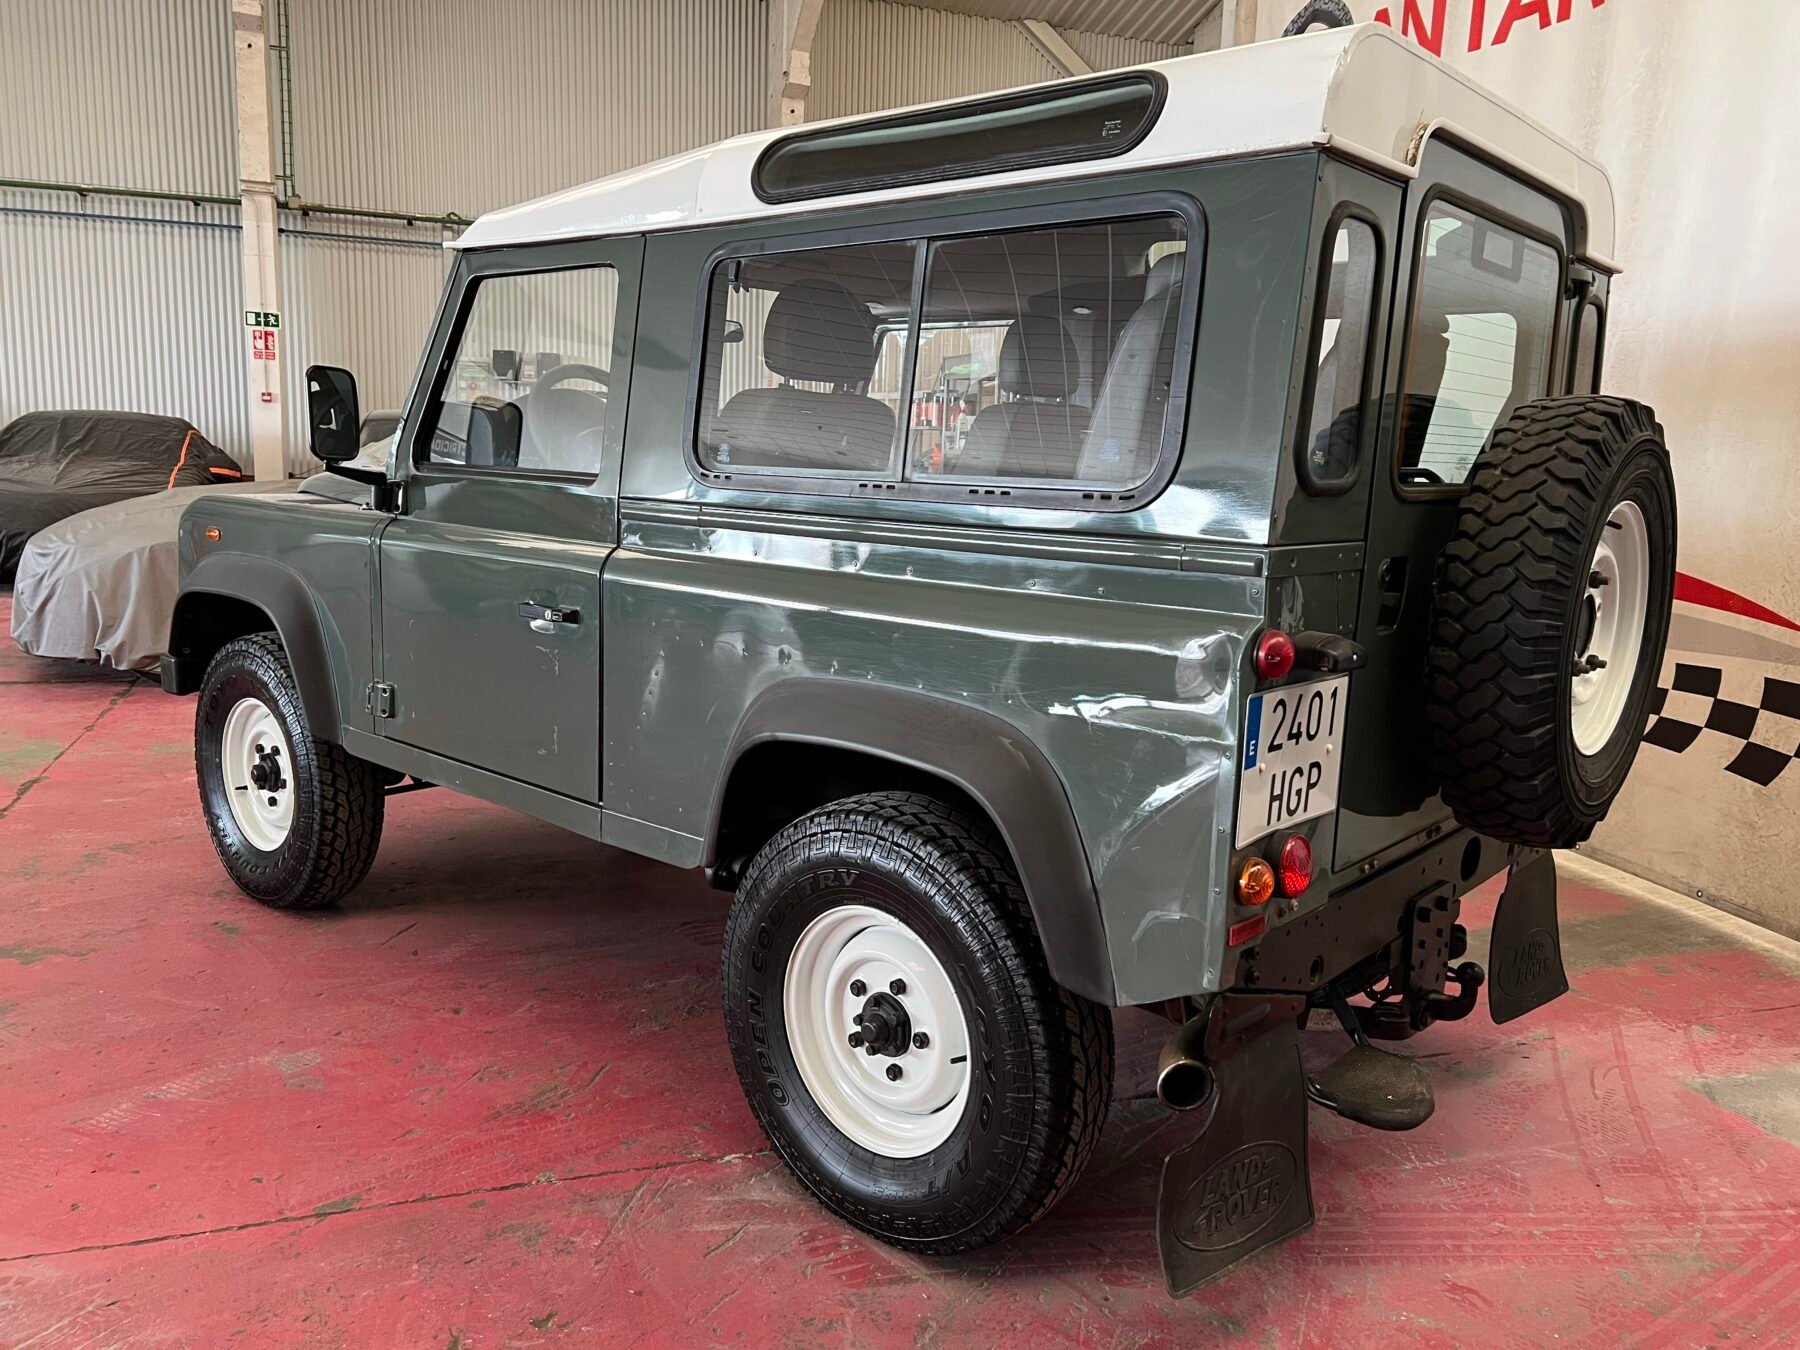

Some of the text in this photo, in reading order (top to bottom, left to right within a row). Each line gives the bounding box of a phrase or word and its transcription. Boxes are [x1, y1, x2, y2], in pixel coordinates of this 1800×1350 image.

[1248, 740, 1256, 756] E
[1267, 686, 1338, 753] 2401
[1267, 760, 1322, 826] HGP
[746, 867, 861, 1106] OPEN COUNTRY
[1201, 1154, 1264, 1206] LAND
[1206, 1178, 1281, 1236] ROVER
